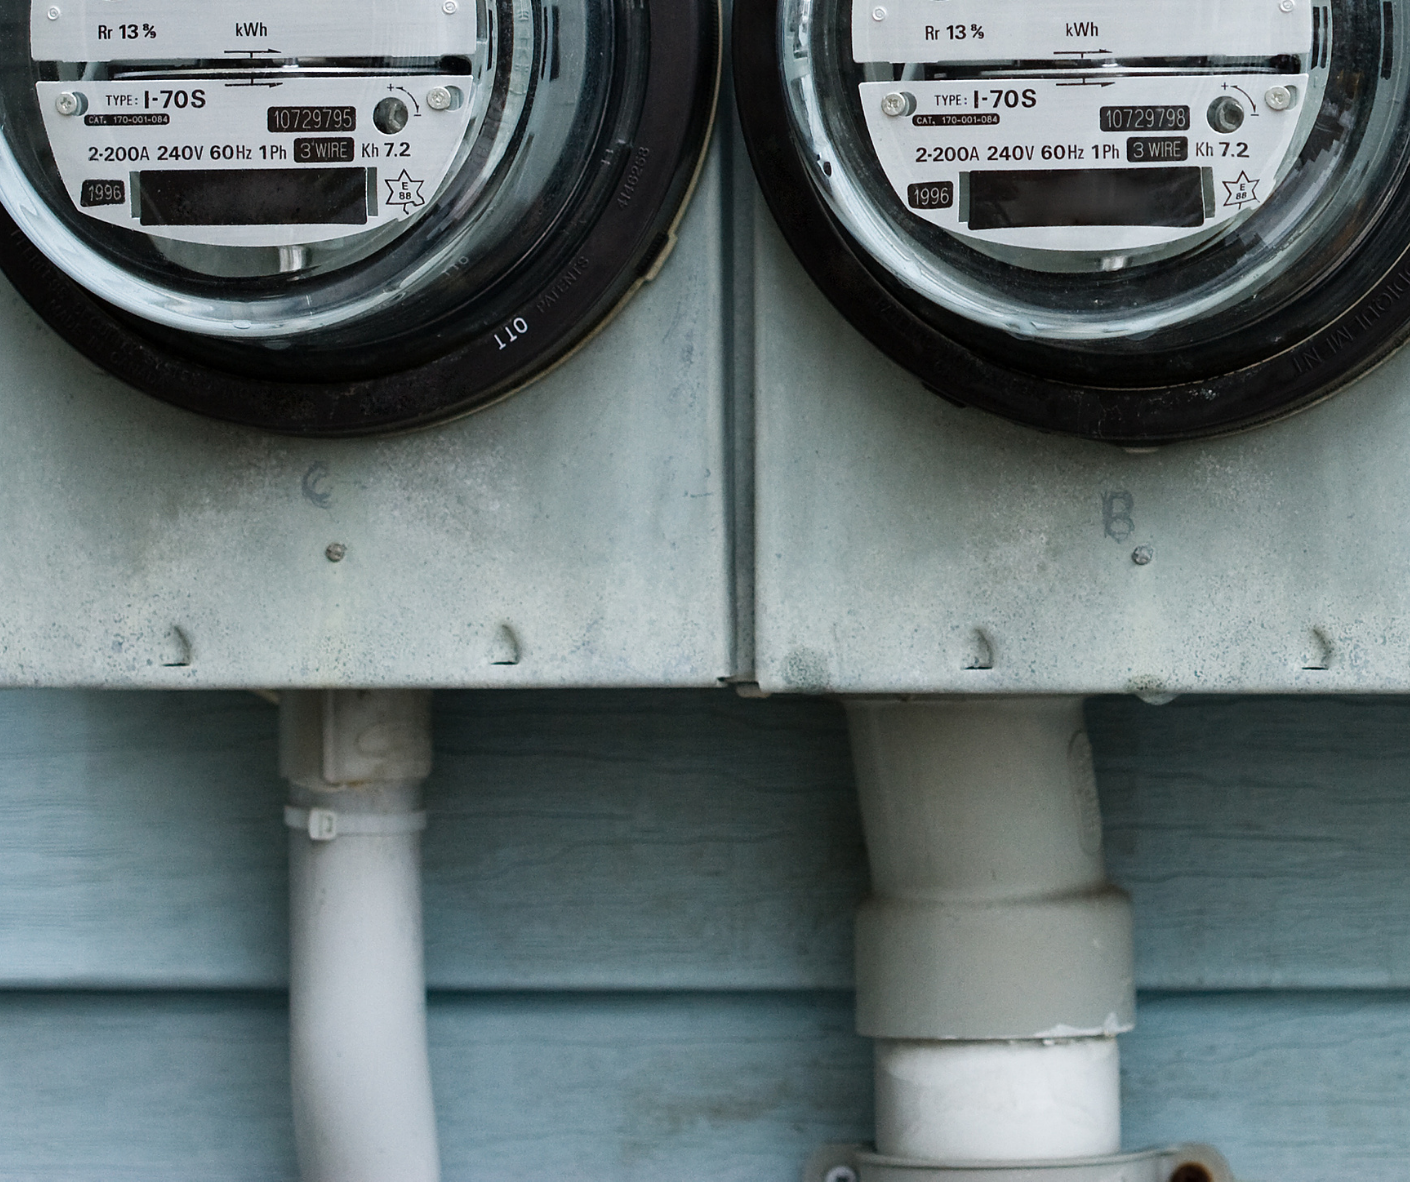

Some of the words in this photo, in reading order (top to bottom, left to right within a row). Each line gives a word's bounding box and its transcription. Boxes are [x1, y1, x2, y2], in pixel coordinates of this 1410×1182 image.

[97, 24, 113, 40] Rr
[118, 23, 139, 40] 13
[235, 21, 268, 37] kWh
[924, 25, 941, 41] Rr
[946, 24, 967, 40] 13
[1065, 21, 1099, 37] kWh
[113, 115, 168, 124] 170-001-084
[274, 108, 353, 129] 10729795
[941, 115, 998, 125] 170-001-084
[1106, 107, 1186, 129] 10729798
[157, 145, 204, 161] 240V
[315, 141, 348, 159] WIRE
[383, 141, 411, 158] 7.2
[986, 145, 1035, 161] 240V
[1133, 141, 1145, 159] 3
[1147, 140, 1182, 158] WIRE
[1218, 141, 1250, 159] 7.2
[88, 183, 122, 202] 1996
[914, 186, 950, 206] 1996
[535, 255, 590, 314] PATENTS
